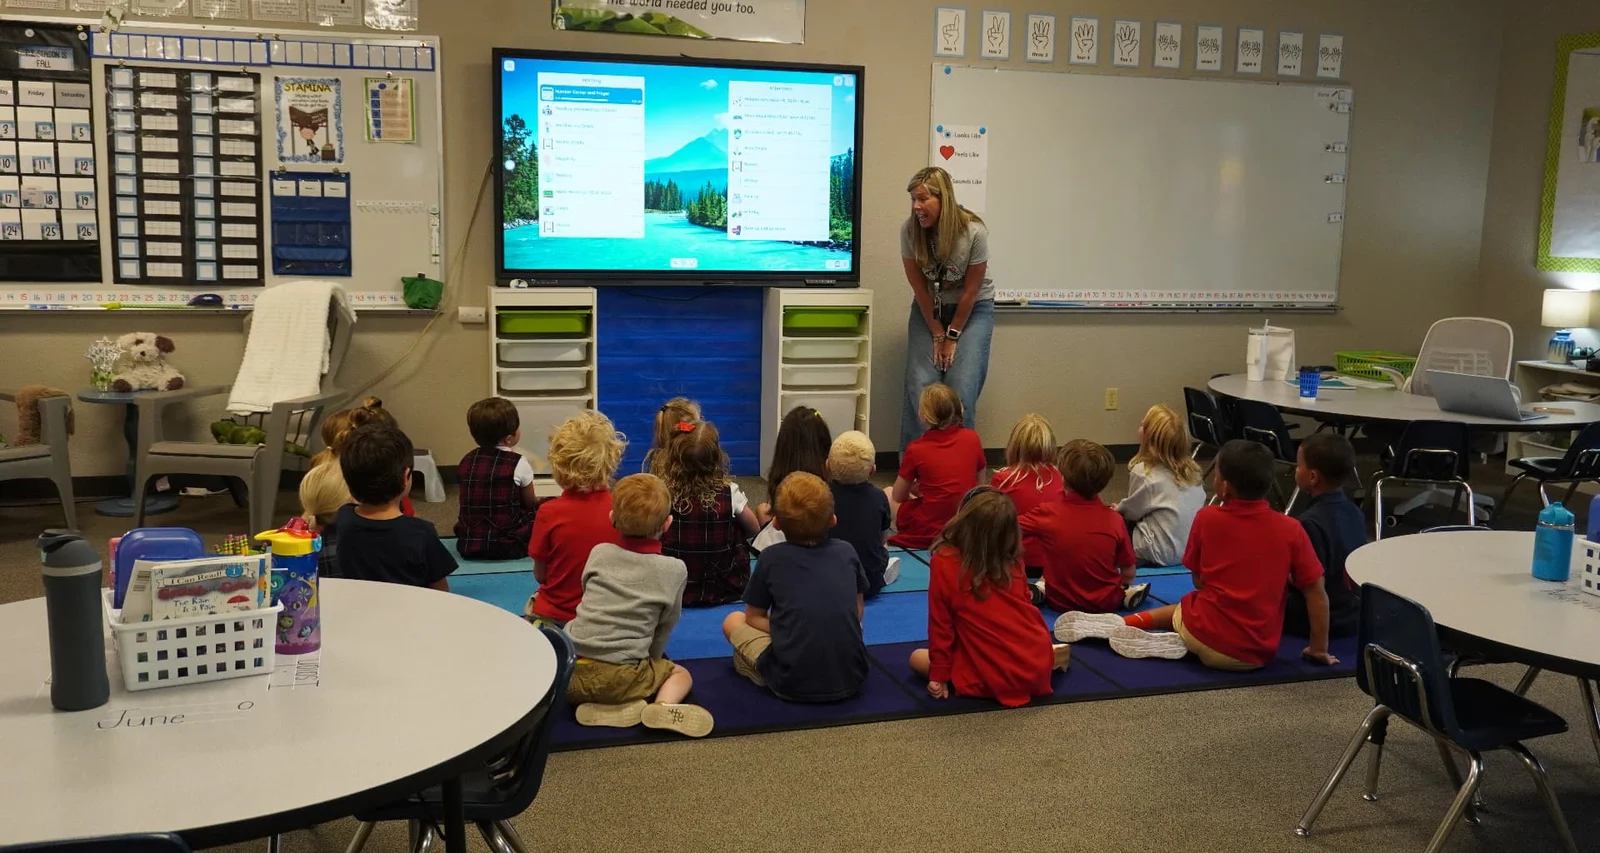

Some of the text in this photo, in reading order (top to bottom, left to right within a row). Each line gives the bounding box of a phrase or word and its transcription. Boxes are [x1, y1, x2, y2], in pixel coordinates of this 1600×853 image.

[629, 0, 662, 8] world
[665, 0, 708, 11] needed
[710, 2, 732, 15] you
[736, 2, 756, 14] too.
[36, 60, 51, 68] FALL
[284, 82, 332, 93] STAMINA
[3, 124, 8, 134] 3
[80, 128, 84, 137] 5
[2, 159, 10, 168] 10
[39, 160, 46, 170] 11
[80, 161, 88, 172] 12
[5, 194, 12, 204] 17
[45, 195, 53, 205] 18
[82, 196, 89, 206] 19
[6, 226, 17, 236] 24
[46, 226, 56, 236] 25
[82, 226, 92, 236] 26
[176, 576, 196, 584] Can
[198, 571, 222, 581] Read!
[97, 709, 185, 729] June
